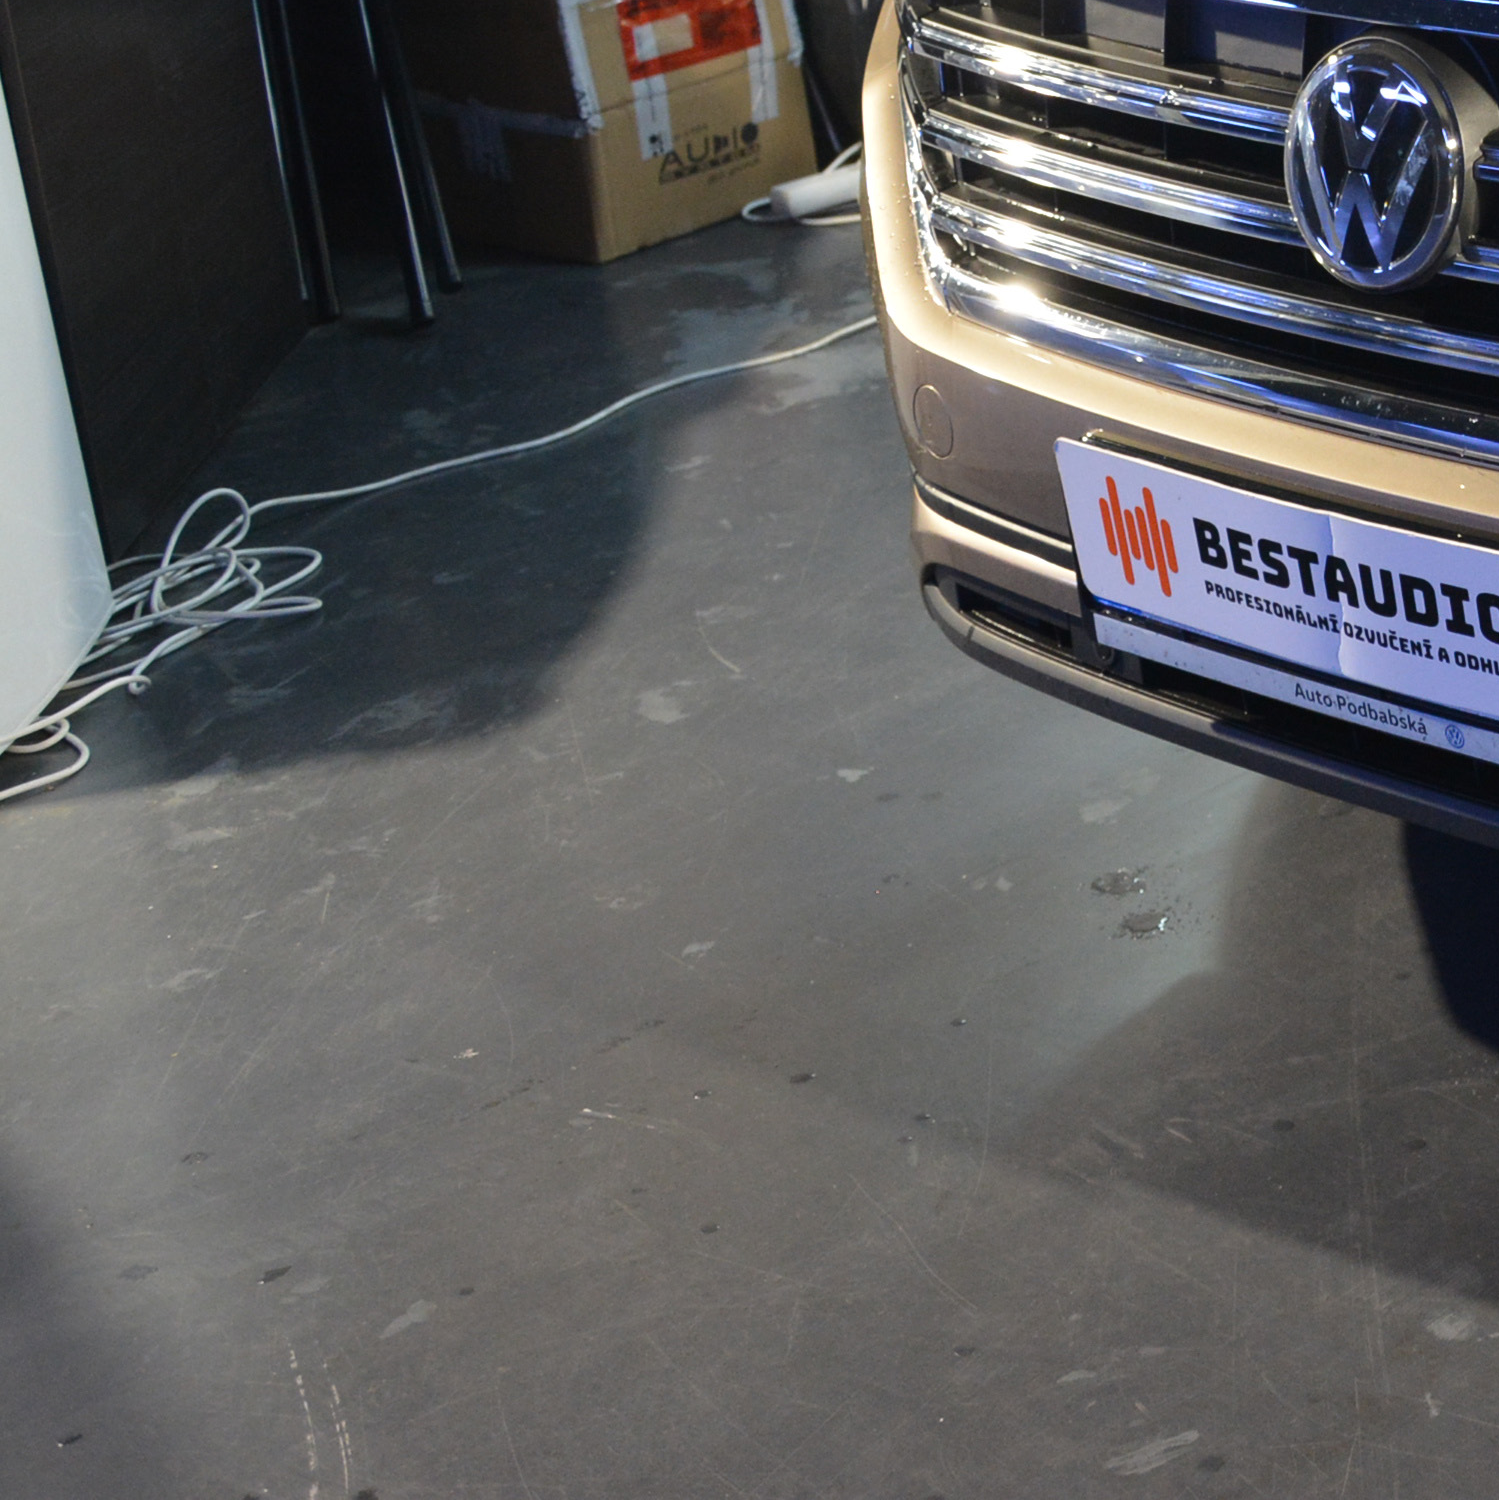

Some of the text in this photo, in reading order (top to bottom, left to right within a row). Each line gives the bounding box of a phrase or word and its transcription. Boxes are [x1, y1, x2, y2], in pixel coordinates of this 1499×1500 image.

[1204, 579, 1341, 635] PROFESIONÁLNÍ
[1343, 620, 1434, 660] OZVUČENÍ
[1438, 646, 1451, 665] A
[1294, 682, 1333, 708] Auto
[1336, 694, 1428, 736] Podbabská
